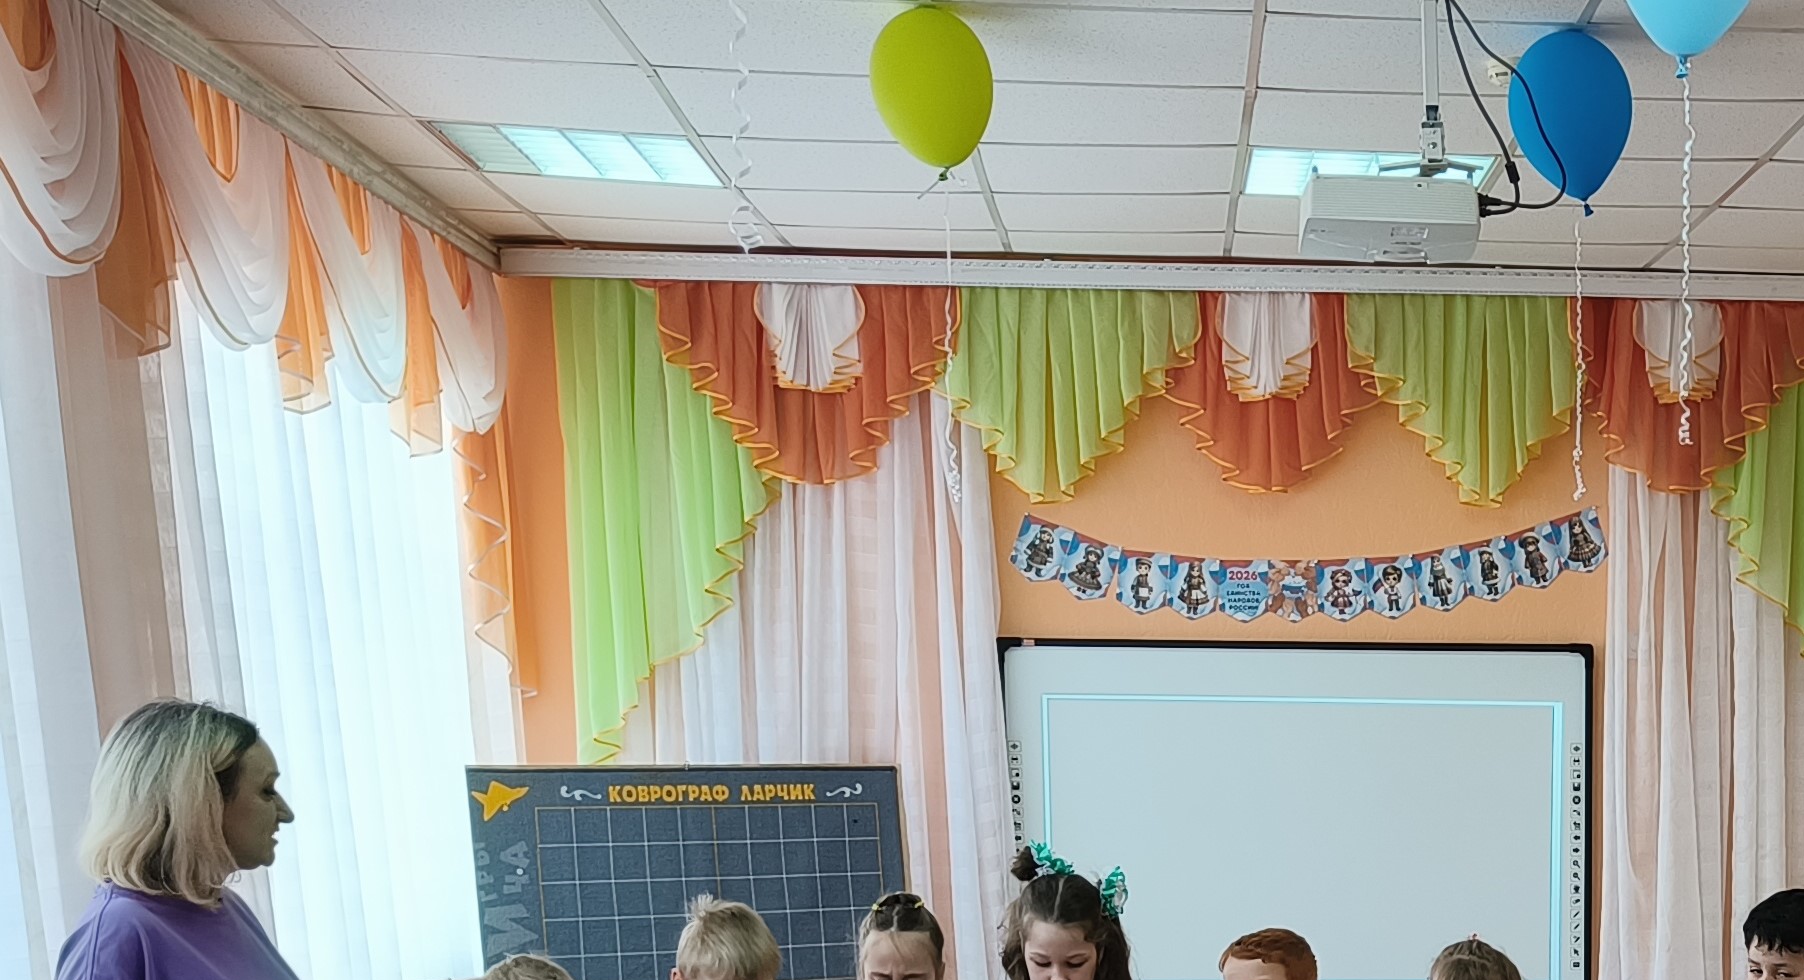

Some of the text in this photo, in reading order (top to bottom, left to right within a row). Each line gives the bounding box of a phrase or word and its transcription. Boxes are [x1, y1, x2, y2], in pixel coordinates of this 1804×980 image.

[1229, 571, 1258, 581] 2026
[608, 784, 815, 803] КОВРОГРАФ ЛАРЧИК
